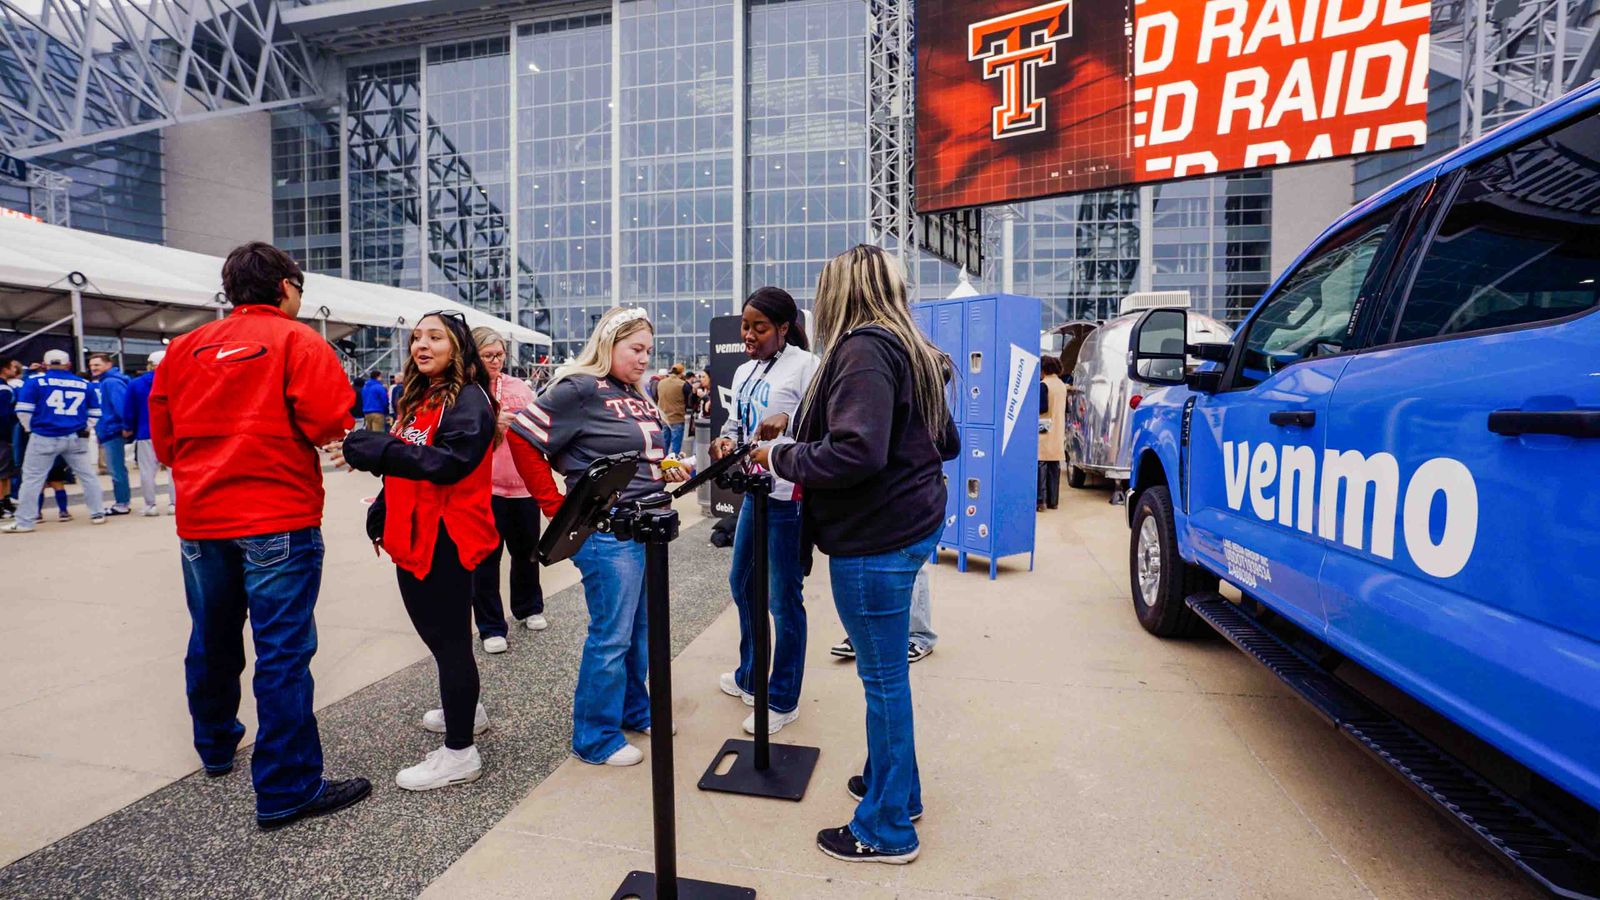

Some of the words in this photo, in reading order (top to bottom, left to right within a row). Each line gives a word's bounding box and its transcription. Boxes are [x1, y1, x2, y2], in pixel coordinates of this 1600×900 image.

[715, 343, 746, 353] venmo
[1013, 358, 1025, 395] venmo
[46, 389, 86, 416] 47
[1007, 398, 1018, 421] hall
[716, 502, 735, 514] debit
[1223, 440, 1479, 578] venmo
